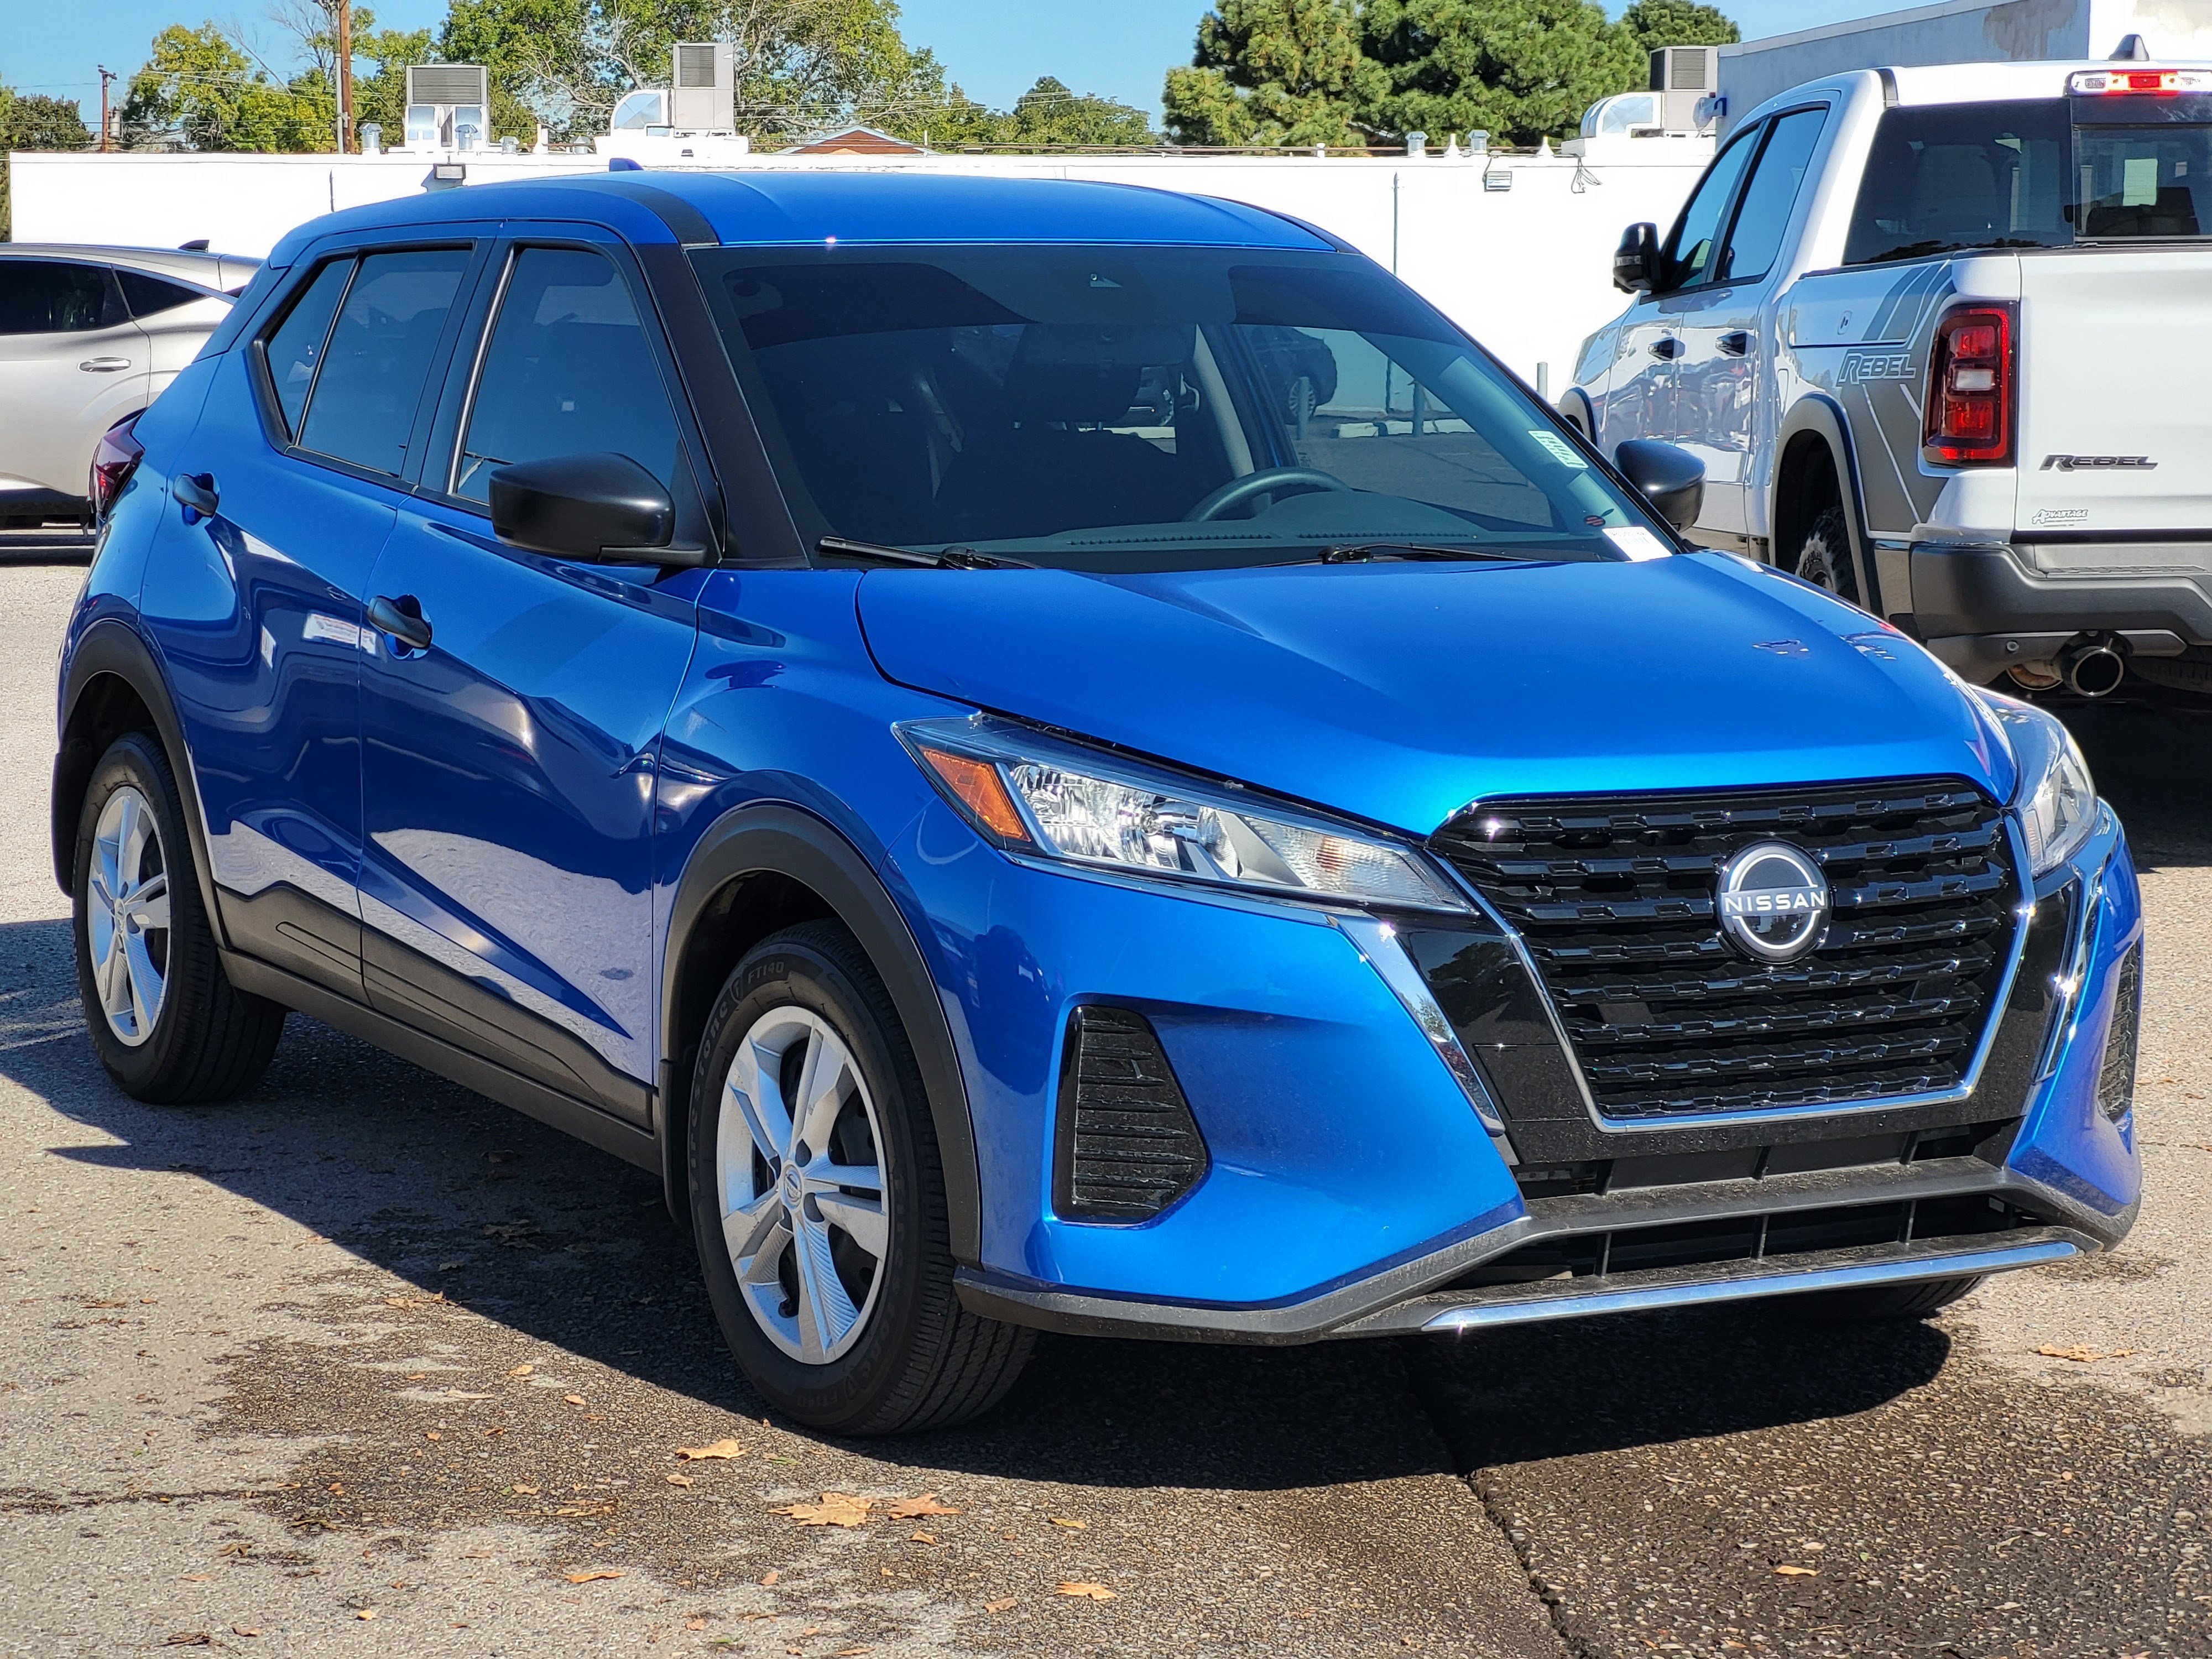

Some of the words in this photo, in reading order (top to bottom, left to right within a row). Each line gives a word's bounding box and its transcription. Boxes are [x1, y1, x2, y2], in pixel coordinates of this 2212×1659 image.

[1839, 353, 1917, 385] REBEL
[2039, 455, 2158, 472] REBEL
[2032, 509, 2088, 524] ADVANTAGE
[1725, 890, 1825, 912] NISSAN
[748, 962, 784, 984] FT140
